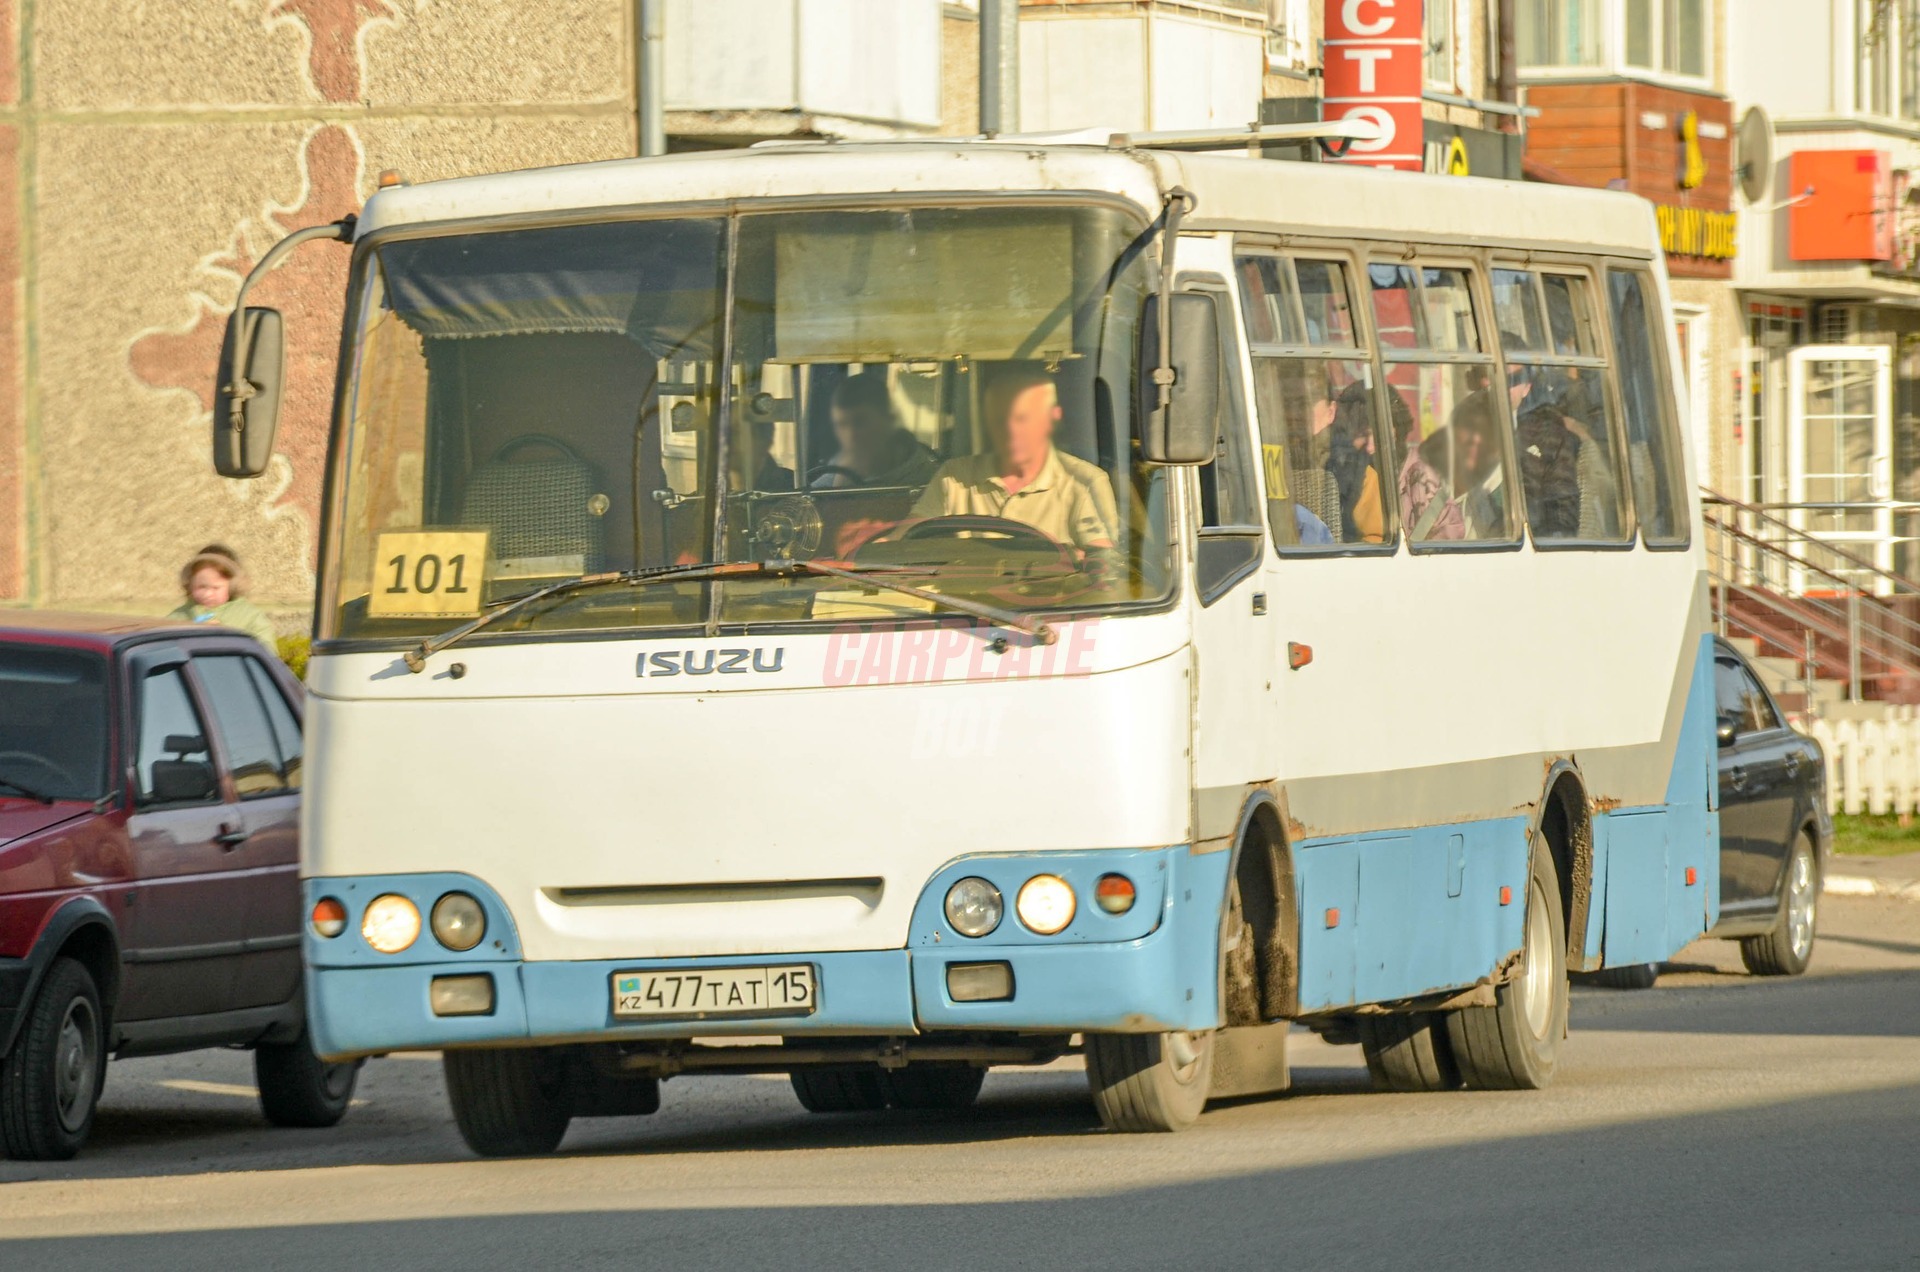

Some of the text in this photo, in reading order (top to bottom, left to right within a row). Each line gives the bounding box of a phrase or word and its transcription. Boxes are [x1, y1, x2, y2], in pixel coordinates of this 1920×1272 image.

[386, 554, 468, 594] 101
[636, 647, 784, 677] ISUZU
[773, 972, 808, 1003] 15
[619, 996, 642, 1010] KZ
